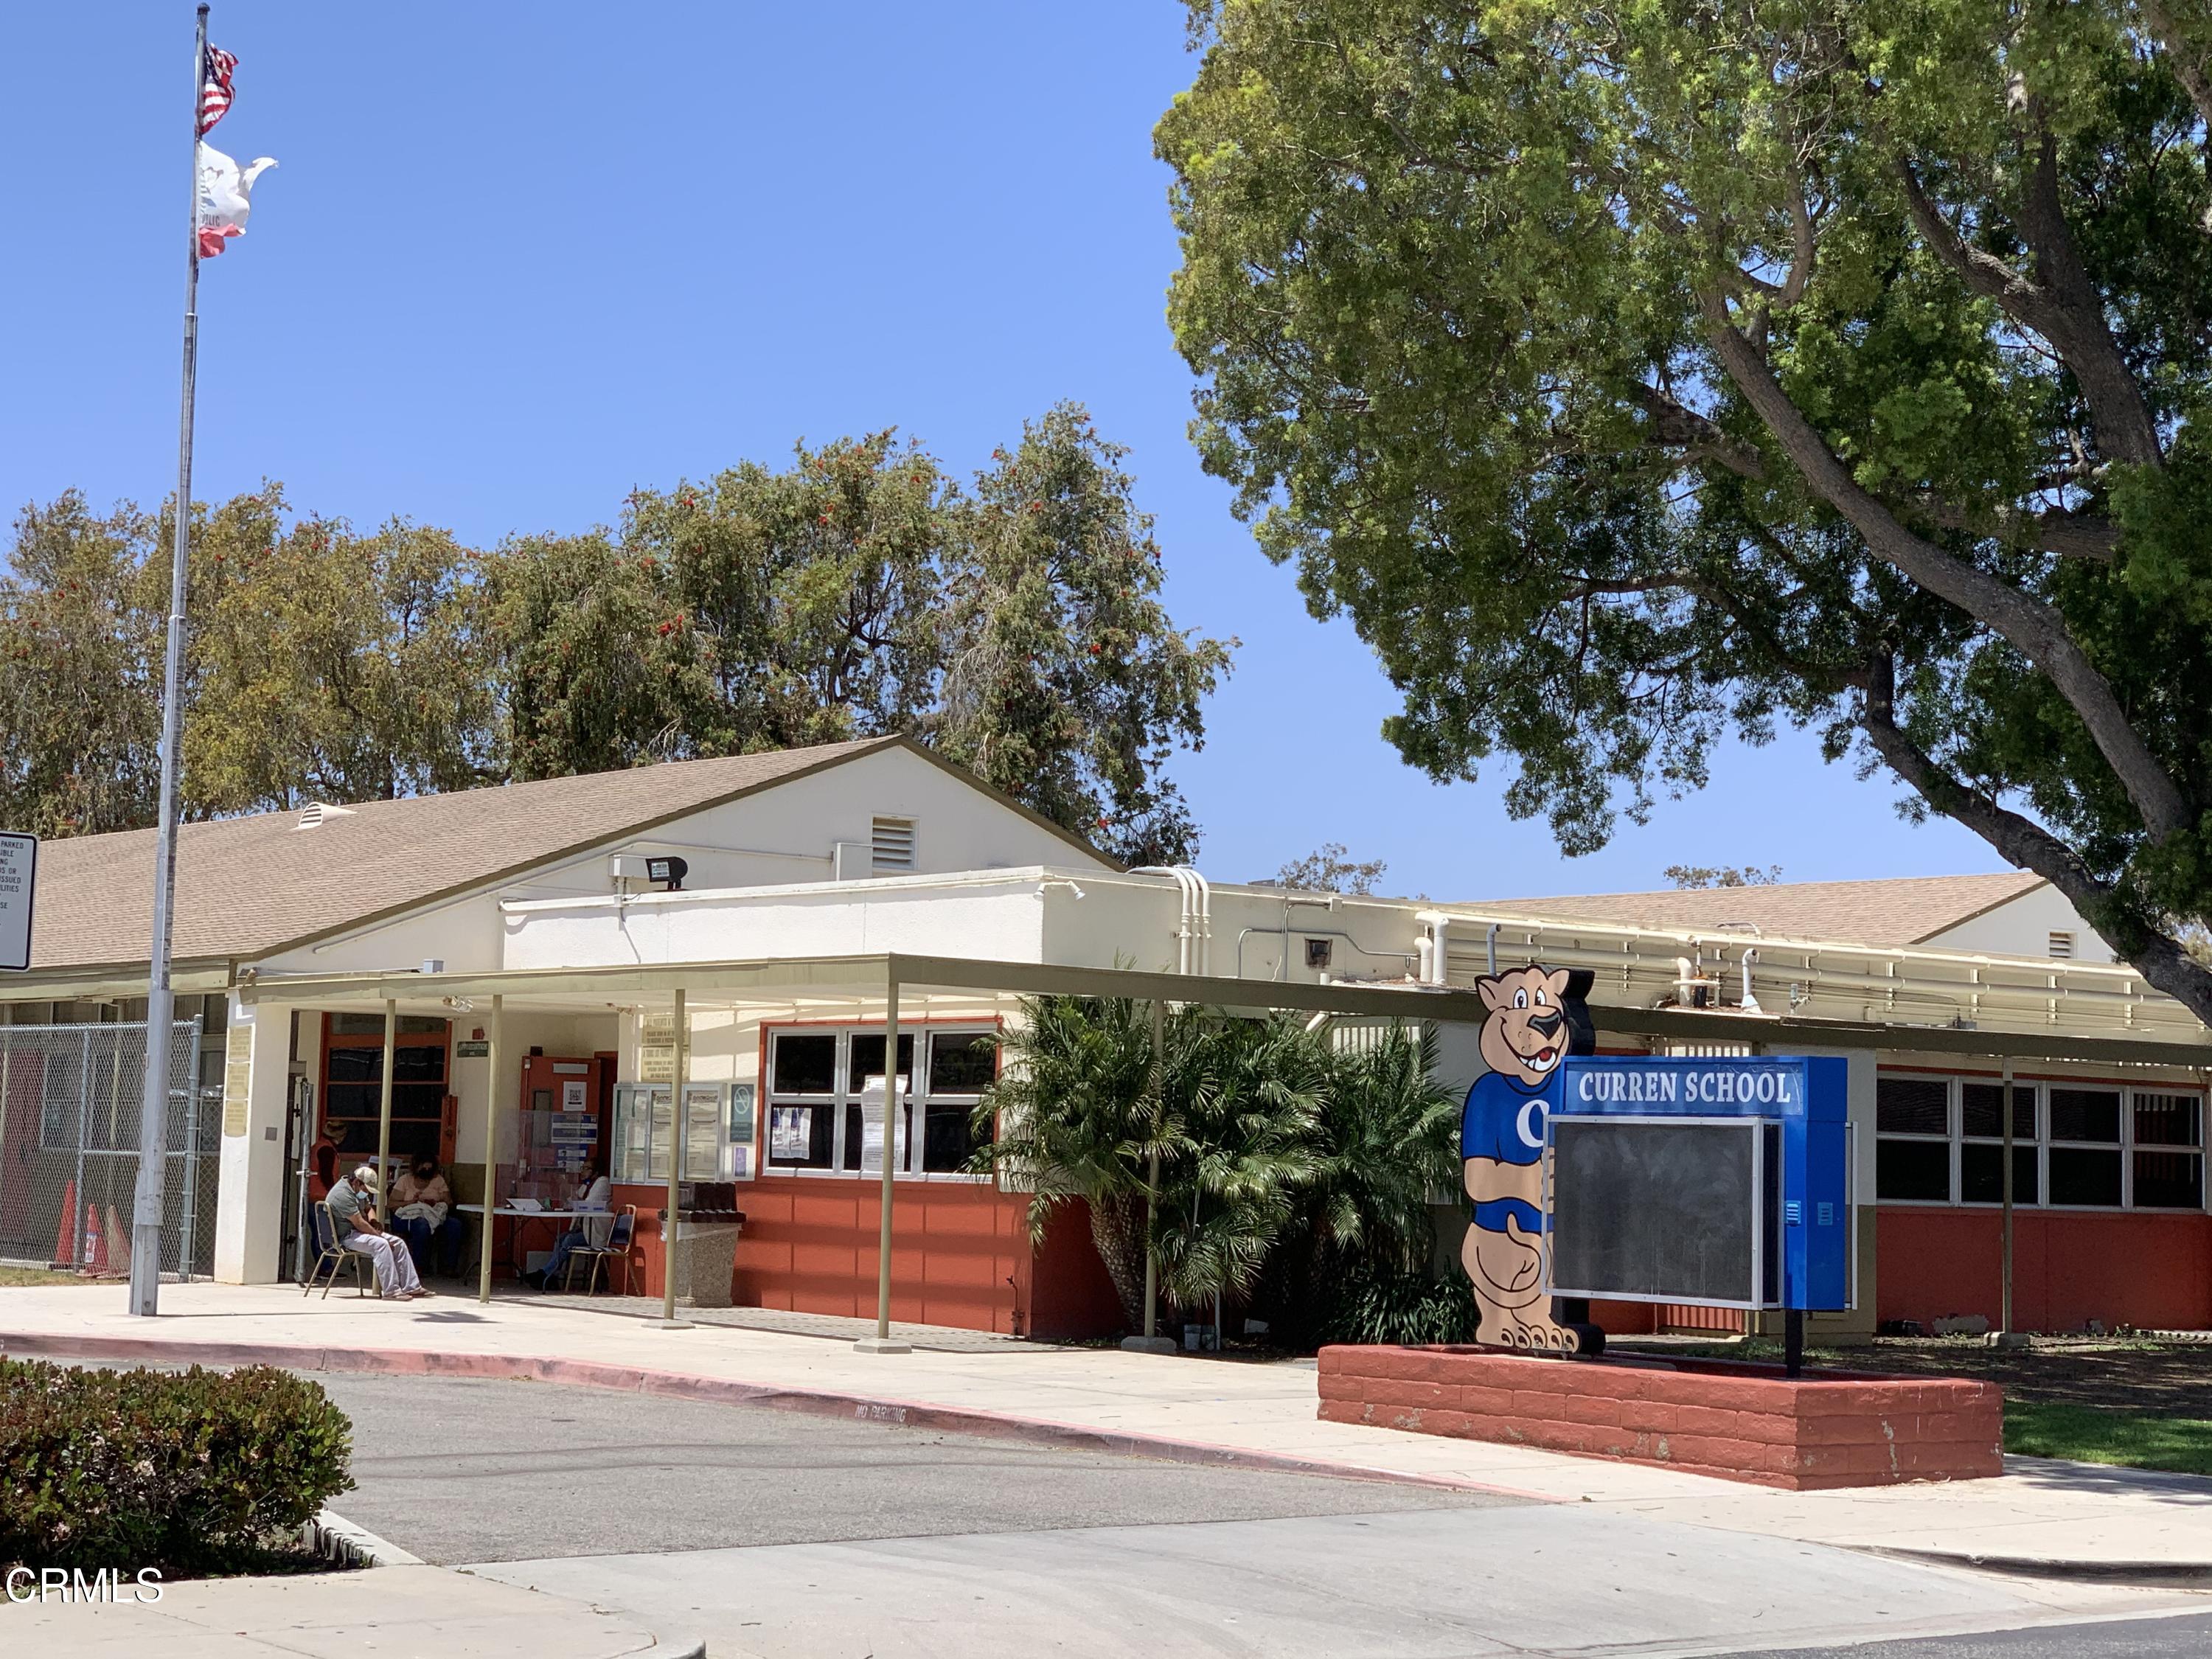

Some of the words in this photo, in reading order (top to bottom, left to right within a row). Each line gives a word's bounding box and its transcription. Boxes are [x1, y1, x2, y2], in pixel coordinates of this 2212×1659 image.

[1, 841, 24, 849] PARKED
[1579, 1071, 1677, 1102] CURREN
[1685, 1071, 1791, 1103] SCHOOL
[855, 1404, 868, 1419] NO
[871, 1405, 906, 1422] PARKING
